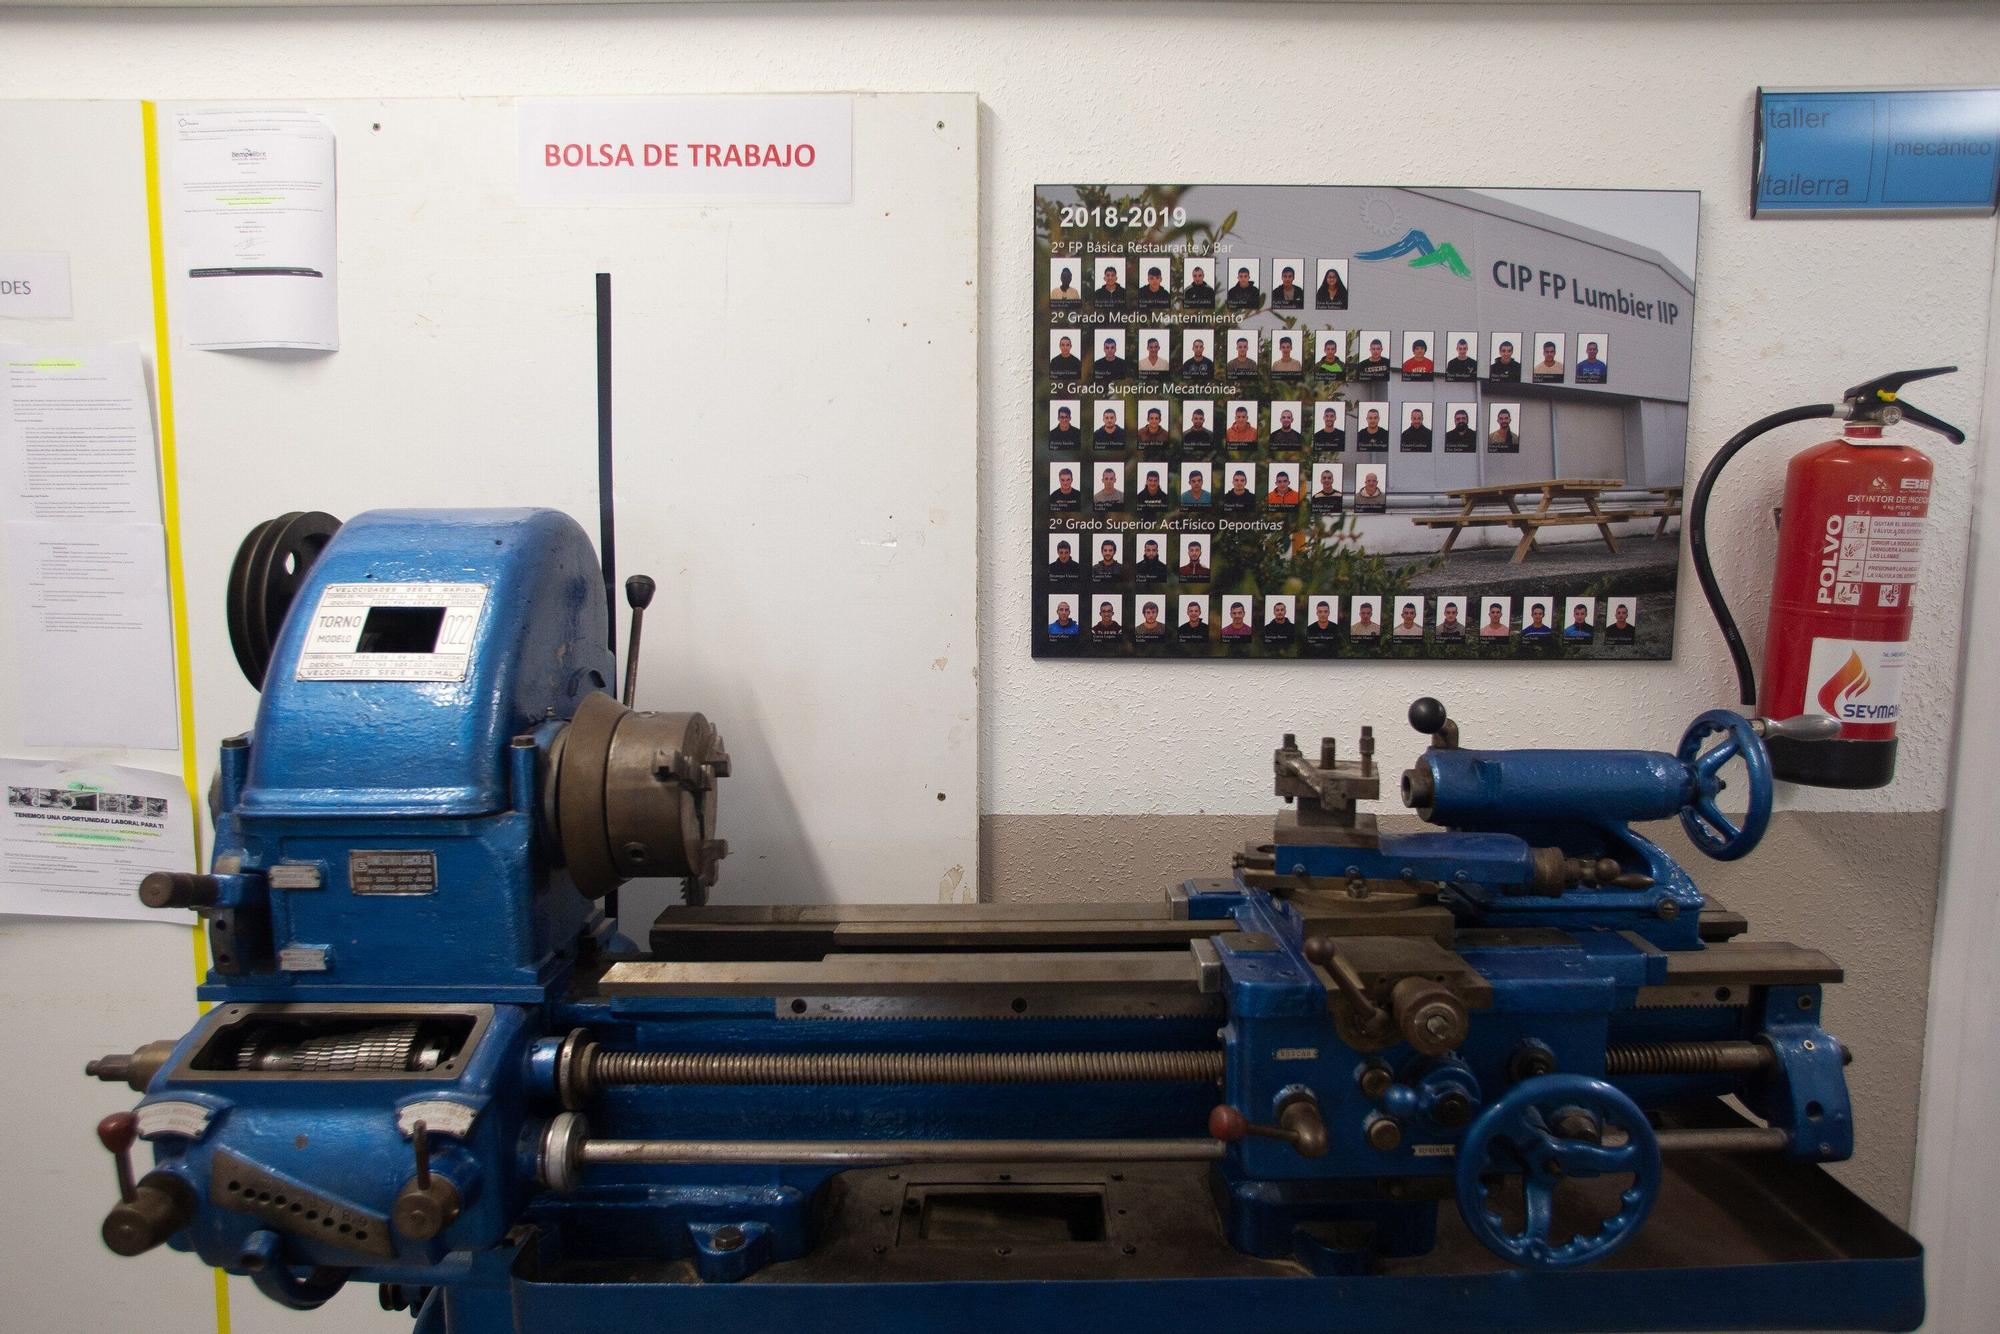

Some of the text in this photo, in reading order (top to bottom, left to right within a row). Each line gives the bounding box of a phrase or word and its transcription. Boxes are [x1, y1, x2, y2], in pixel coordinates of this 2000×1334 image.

[1769, 107, 1830, 129] taller
[1894, 139, 1991, 156] mecánico
[544, 143, 816, 169] BOLSA DE TRABAJO
[1764, 174, 1849, 196] tailerra
[1059, 206, 1187, 229] 2018-2019
[1051, 240, 1233, 257] 2º FP Básica Restaurante y Bar
[1, 280, 32, 296] DES
[1492, 260, 1678, 325] CIP FP Lumbier IIP
[1051, 311, 1244, 325] 2º Grado Medio Mantenimiento
[1050, 382, 1237, 397] 2º Grado Superior Mecatrónica
[1847, 494, 1894, 503] EXTINTOR
[1896, 496, 1907, 504] DE
[1049, 518, 1283, 533] 2º Grado Superior Act.Físico Deportivas
[1816, 514, 1843, 605] POLVO
[1851, 584, 1858, 594] A
[1894, 584, 1900, 594] B
[319, 615, 362, 628] TORNO
[441, 614, 473, 645] 022
[317, 634, 352, 643] MODELO
[15, 812, 45, 820] TENEMOS
[62, 815, 110, 824] OPORTUNIDAD
[111, 818, 140, 826] LABORAL
